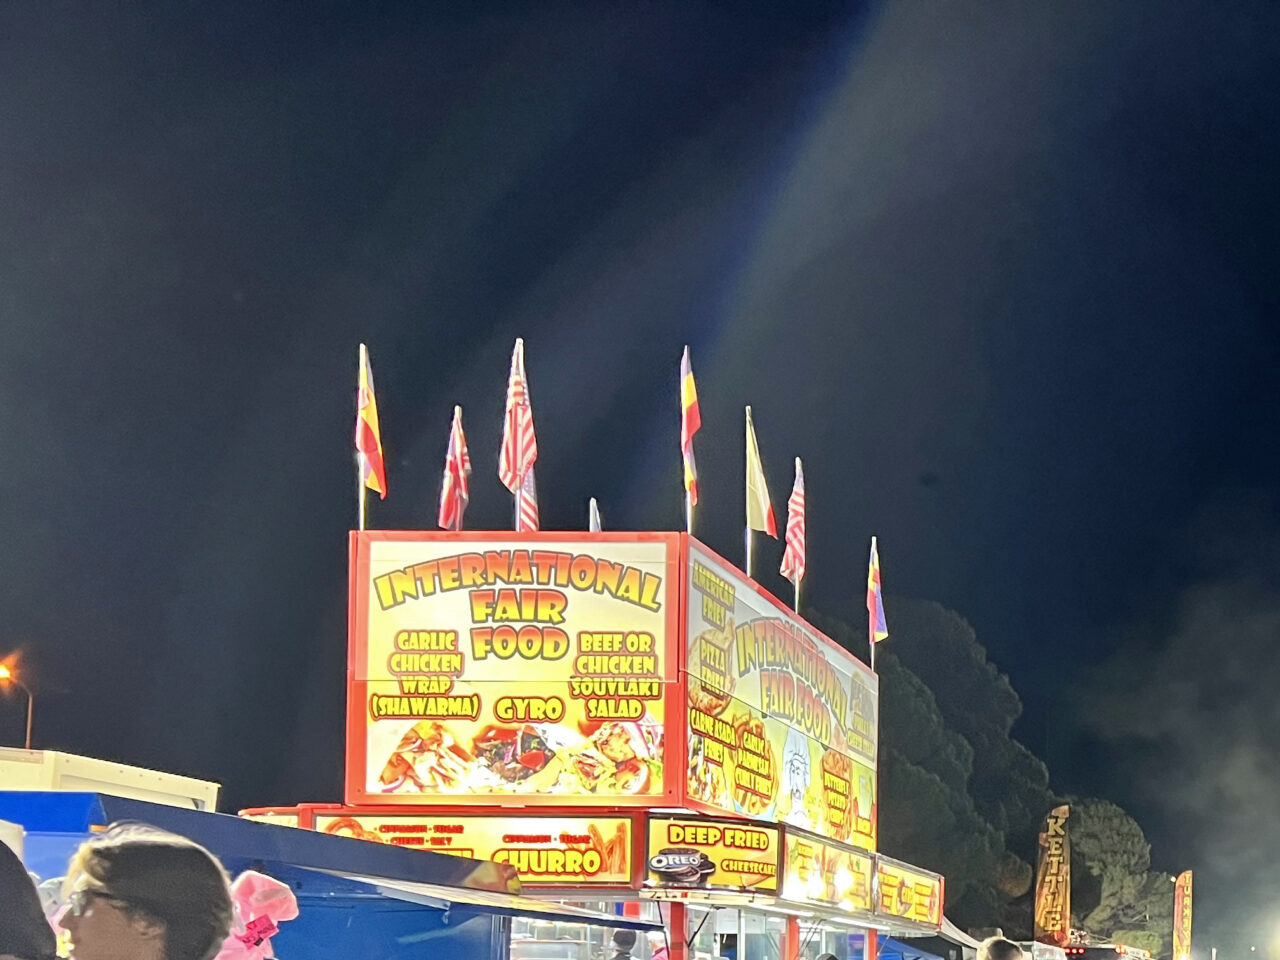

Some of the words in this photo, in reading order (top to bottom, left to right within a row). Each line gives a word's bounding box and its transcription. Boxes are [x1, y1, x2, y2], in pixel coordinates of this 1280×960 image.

[373, 549, 662, 613] INTERNATIONAL
[693, 560, 735, 611] AMERICAN
[469, 588, 568, 624] FAIR
[702, 595, 726, 631] FRIES
[396, 631, 457, 652] GARLIC
[469, 625, 569, 660] FOOD
[579, 632, 623, 653] BEEF
[625, 632, 653, 652] OR
[389, 653, 463, 673] CHICKEN
[575, 655, 656, 675] CHICKEN
[701, 639, 726, 674] PIZZA
[401, 676, 451, 694] WRAP
[571, 678, 661, 698] SOUVLAKI
[735, 616, 849, 737] INTERNATIONAL
[372, 696, 480, 719] (SHAWARMA)
[494, 697, 565, 721] GYRO
[586, 699, 644, 719] SALAD
[760, 668, 796, 722] FAIR
[796, 679, 831, 747] FOOD
[690, 709, 714, 738] CARNE
[714, 719, 736, 749] ASADA
[704, 737, 724, 766] FRIES
[743, 731, 765, 758] GARLIC
[668, 824, 721, 846] DEEP
[723, 828, 769, 851] FRIED
[493, 849, 601, 875] CHURRO
[650, 855, 699, 868] OREO
[721, 859, 776, 876] CHEESECAKE
[1045, 817, 1067, 931] KETTLE
